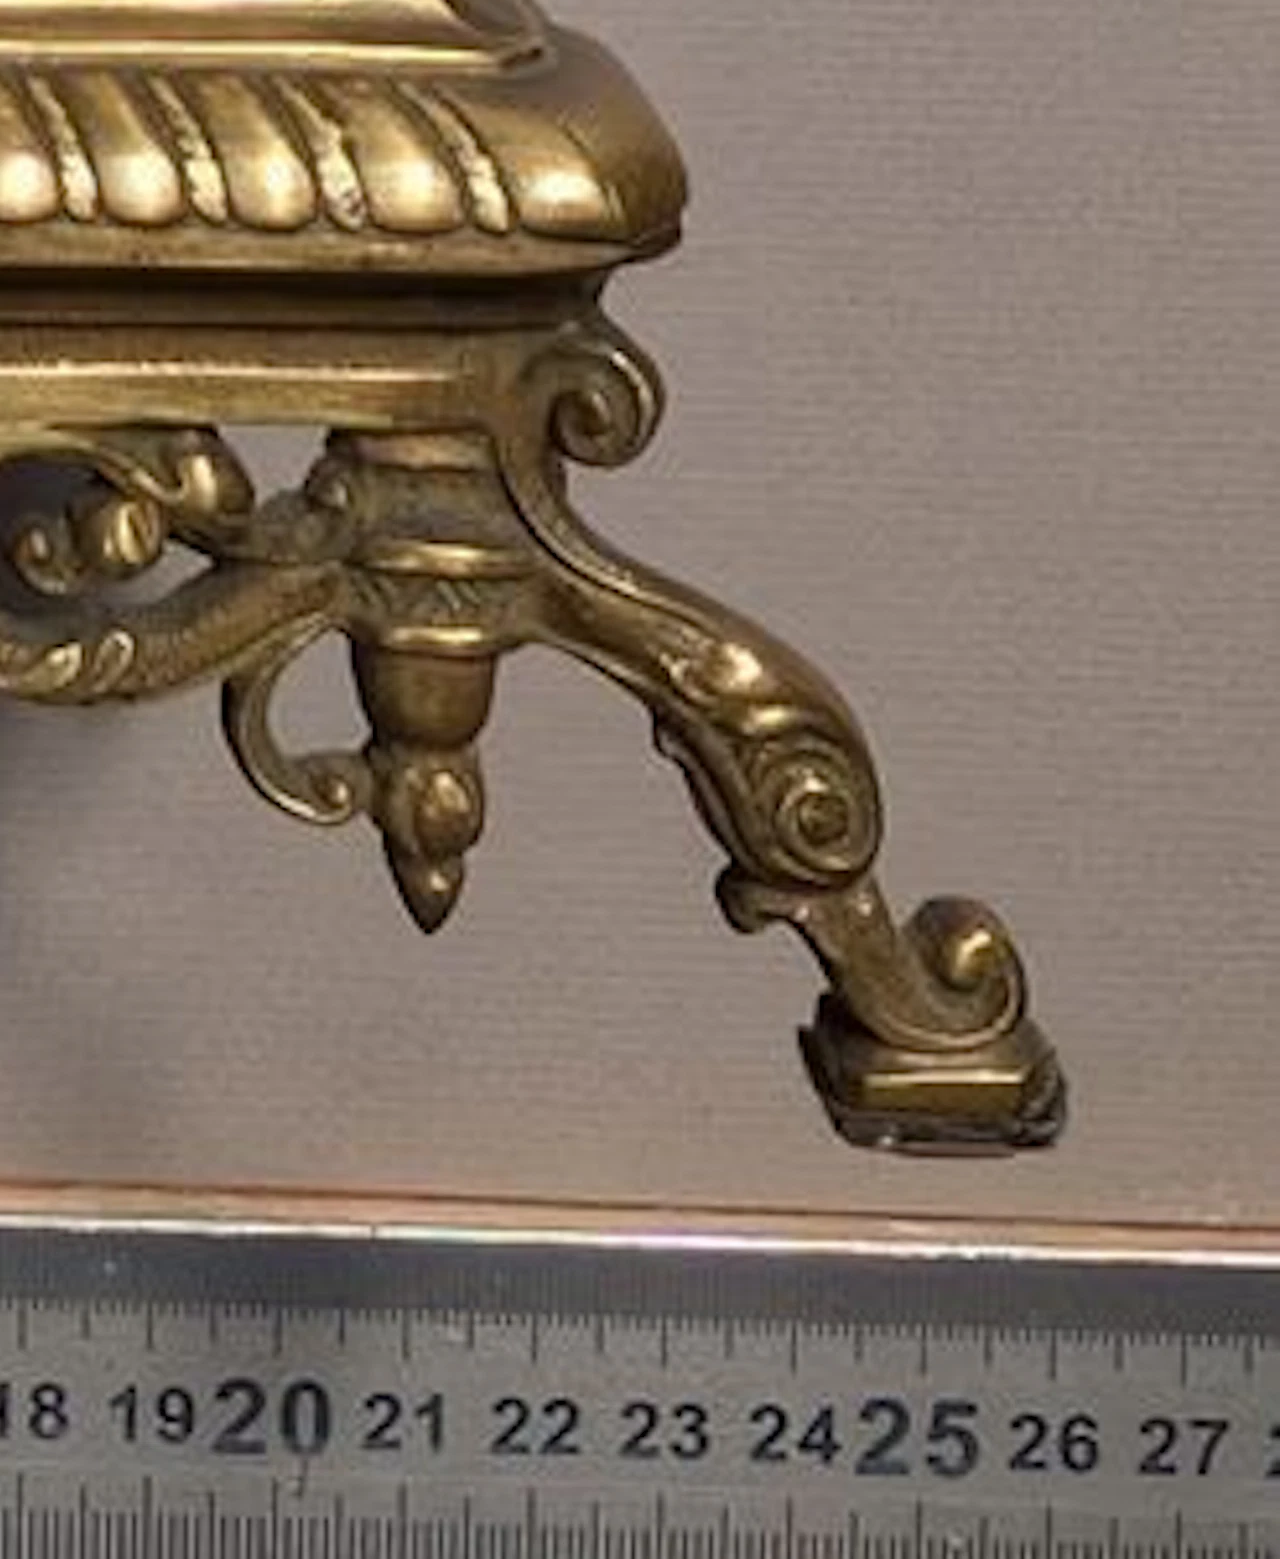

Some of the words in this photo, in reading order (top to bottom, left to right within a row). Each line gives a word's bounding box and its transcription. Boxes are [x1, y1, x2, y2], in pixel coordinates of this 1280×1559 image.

[110, 1385, 195, 1443] 19
[212, 1378, 330, 1454] 20
[362, 1393, 442, 1452] 21
[491, 1397, 580, 1455] 22
[620, 1401, 710, 1460] 23
[750, 1404, 842, 1464] 24
[856, 1399, 978, 1478] 25
[1009, 1414, 1099, 1474] 26
[1138, 1417, 1230, 1476] 27
